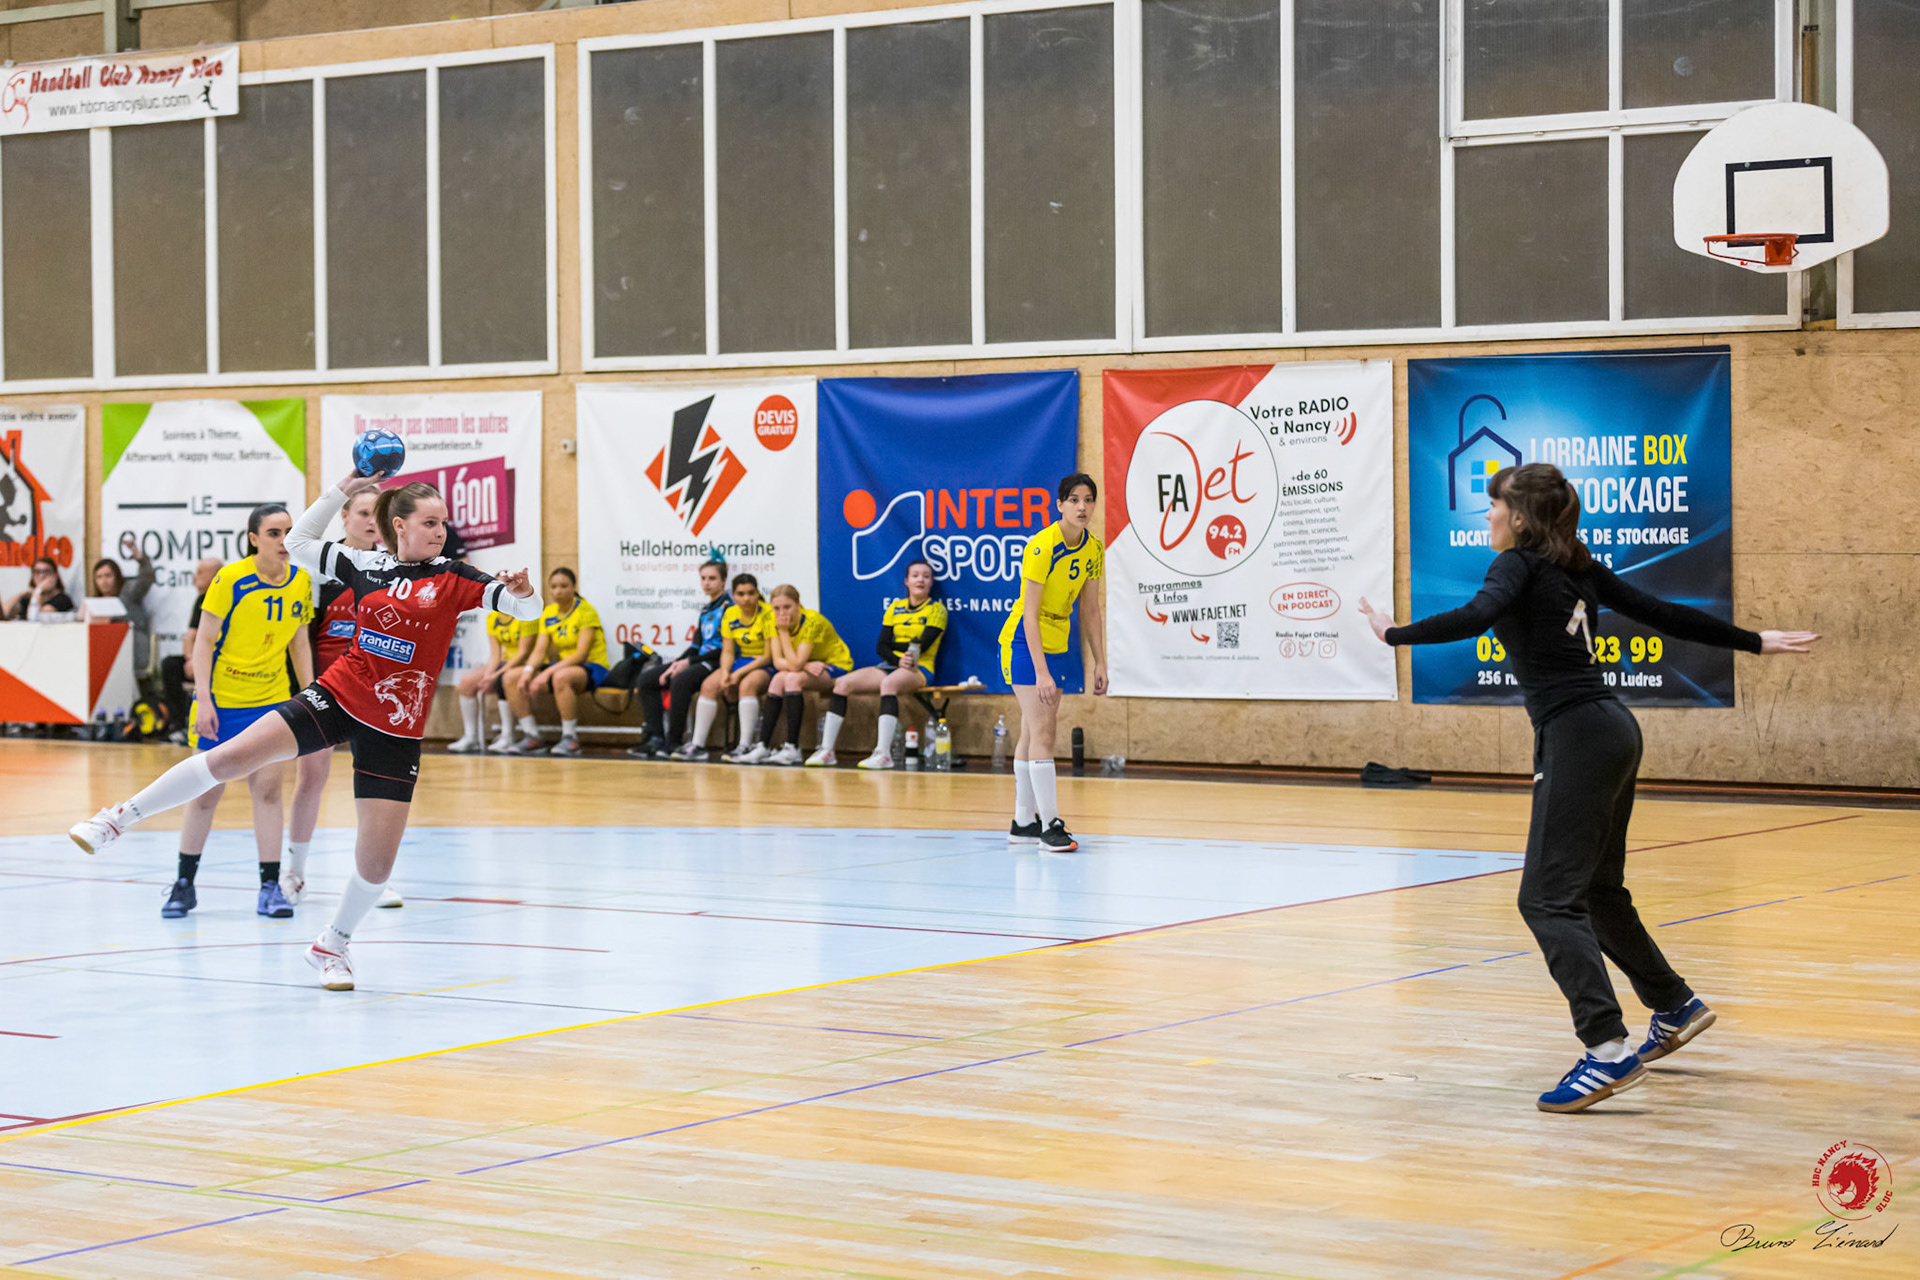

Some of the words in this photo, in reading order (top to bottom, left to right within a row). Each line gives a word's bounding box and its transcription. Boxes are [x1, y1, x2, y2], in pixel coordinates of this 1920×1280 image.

[30, 66, 92, 94] Handball
[100, 64, 133, 87] Club
[189, 56, 224, 79] Sluc
[49, 94, 191, 117] www.hbcnancysluc.com
[757, 410, 795, 424] DEVIS
[1250, 405, 1294, 420] Votre
[1298, 396, 1349, 415] RADIO
[757, 425, 795, 436] GRATUIT
[1269, 421, 1279, 435] à
[1284, 420, 1331, 435] Nancy
[1279, 437, 1286, 447] &
[1289, 435, 1328, 446] environs
[1643, 434, 1688, 465] BOX
[1314, 469, 1328, 479] 60
[1282, 481, 1343, 497] ÉMISSIONS
[1571, 476, 1689, 514] TOCKAGE
[191, 495, 213, 515] LE
[925, 487, 1051, 529] INTER
[1209, 524, 1242, 539] 94.2
[1450, 529, 1492, 547] LOCAT
[1593, 528, 1613, 545] DE
[1616, 527, 1689, 545] STOCKAGE
[119, 529, 249, 561] COMPTO
[1228, 547, 1240, 555] FM
[635, 561, 679, 572] solution
[682, 563, 700, 573] pou
[742, 562, 775, 573] projet
[922, 534, 1036, 582] SPOR
[1068, 558, 1080, 580] 5
[386, 577, 413, 600] 10
[1138, 580, 1202, 593] Programmes
[1282, 592, 1294, 600] EN
[1297, 589, 1328, 600] DIRECT
[1154, 594, 1160, 603] &
[1163, 592, 1188, 603] Infos
[1278, 603, 1288, 611] EN
[1291, 600, 1333, 610] PODCAST
[263, 595, 283, 622] 11
[1172, 604, 1247, 623] WWW.FAJET.NET
[616, 624, 642, 645] 06
[651, 624, 676, 646] 21
[1295, 631, 1312, 640] Fajet
[1313, 631, 1338, 639] Officiel
[1476, 635, 1507, 662] 03
[1594, 635, 1621, 663] 23
[1630, 635, 1663, 663] 99
[1478, 670, 1501, 686] 256
[1621, 671, 1663, 687] Ludres
